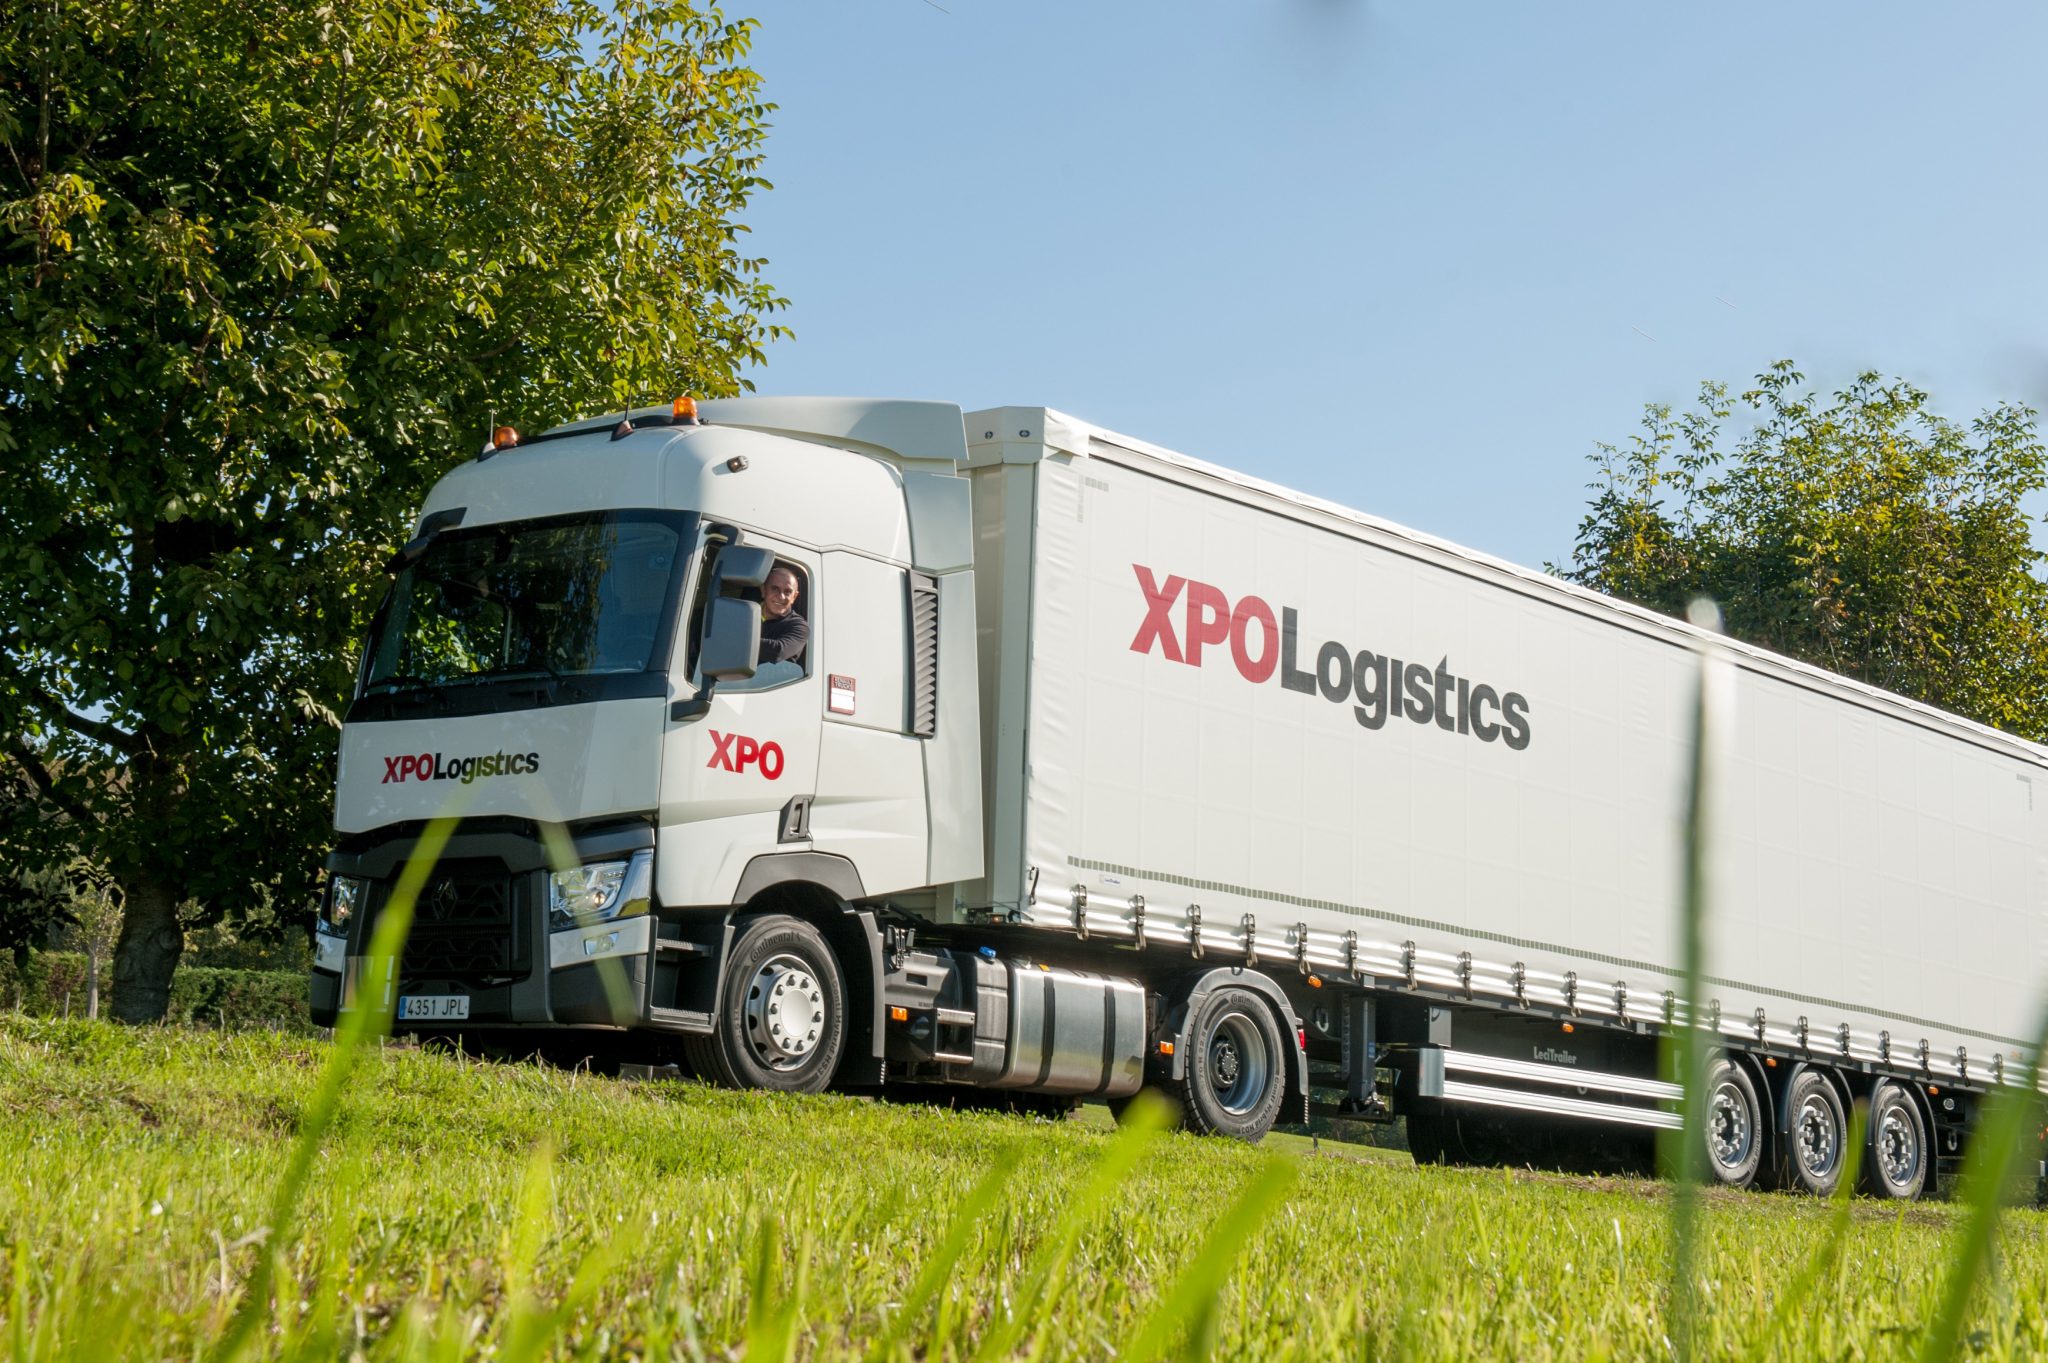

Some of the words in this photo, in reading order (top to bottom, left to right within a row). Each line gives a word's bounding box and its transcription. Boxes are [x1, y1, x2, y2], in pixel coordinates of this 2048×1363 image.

[706, 728, 784, 780] XPO
[407, 999, 436, 1016] 4351
[441, 999, 465, 1016] JPL
